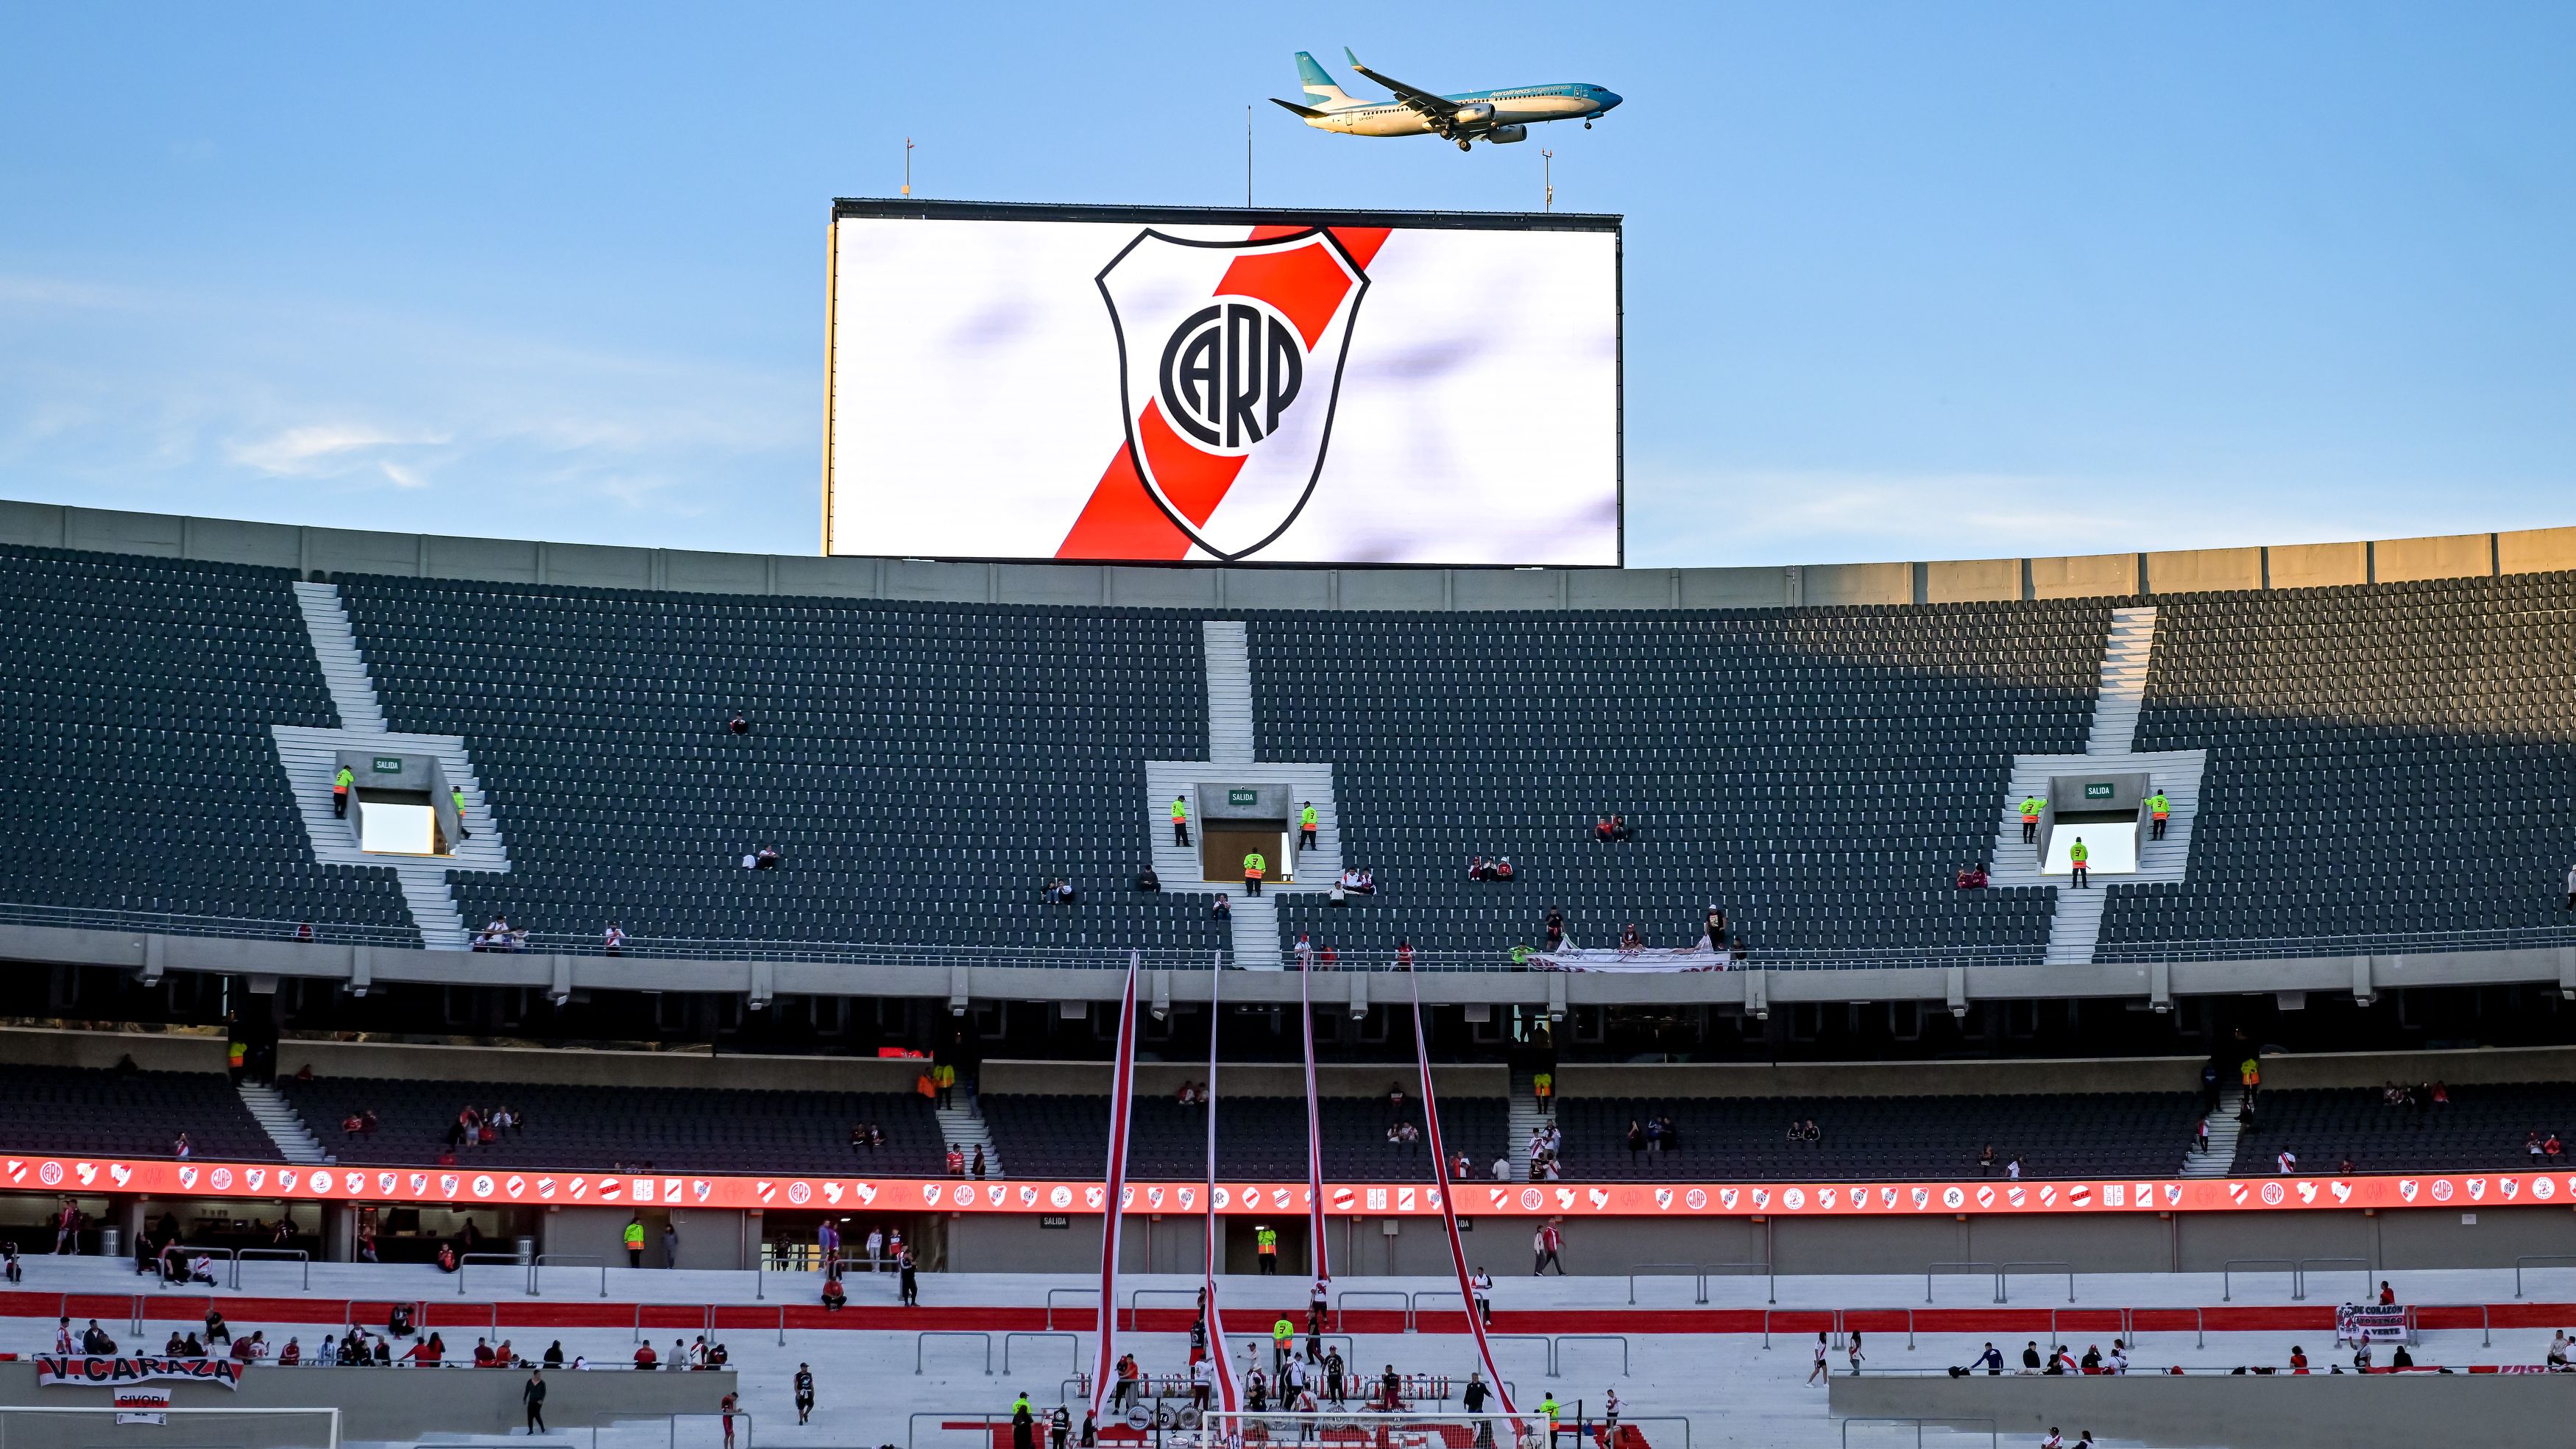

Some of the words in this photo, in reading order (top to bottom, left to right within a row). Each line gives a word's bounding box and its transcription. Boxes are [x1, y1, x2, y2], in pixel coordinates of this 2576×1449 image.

[1159, 303, 1303, 448] CARP
[377, 761, 398, 770] SALIDA
[2088, 787, 2109, 795] SALIDA
[1044, 1216, 1066, 1225] SALIDA
[2354, 1305, 2364, 1314] DE
[120, 1395, 164, 1406] SIVORI
